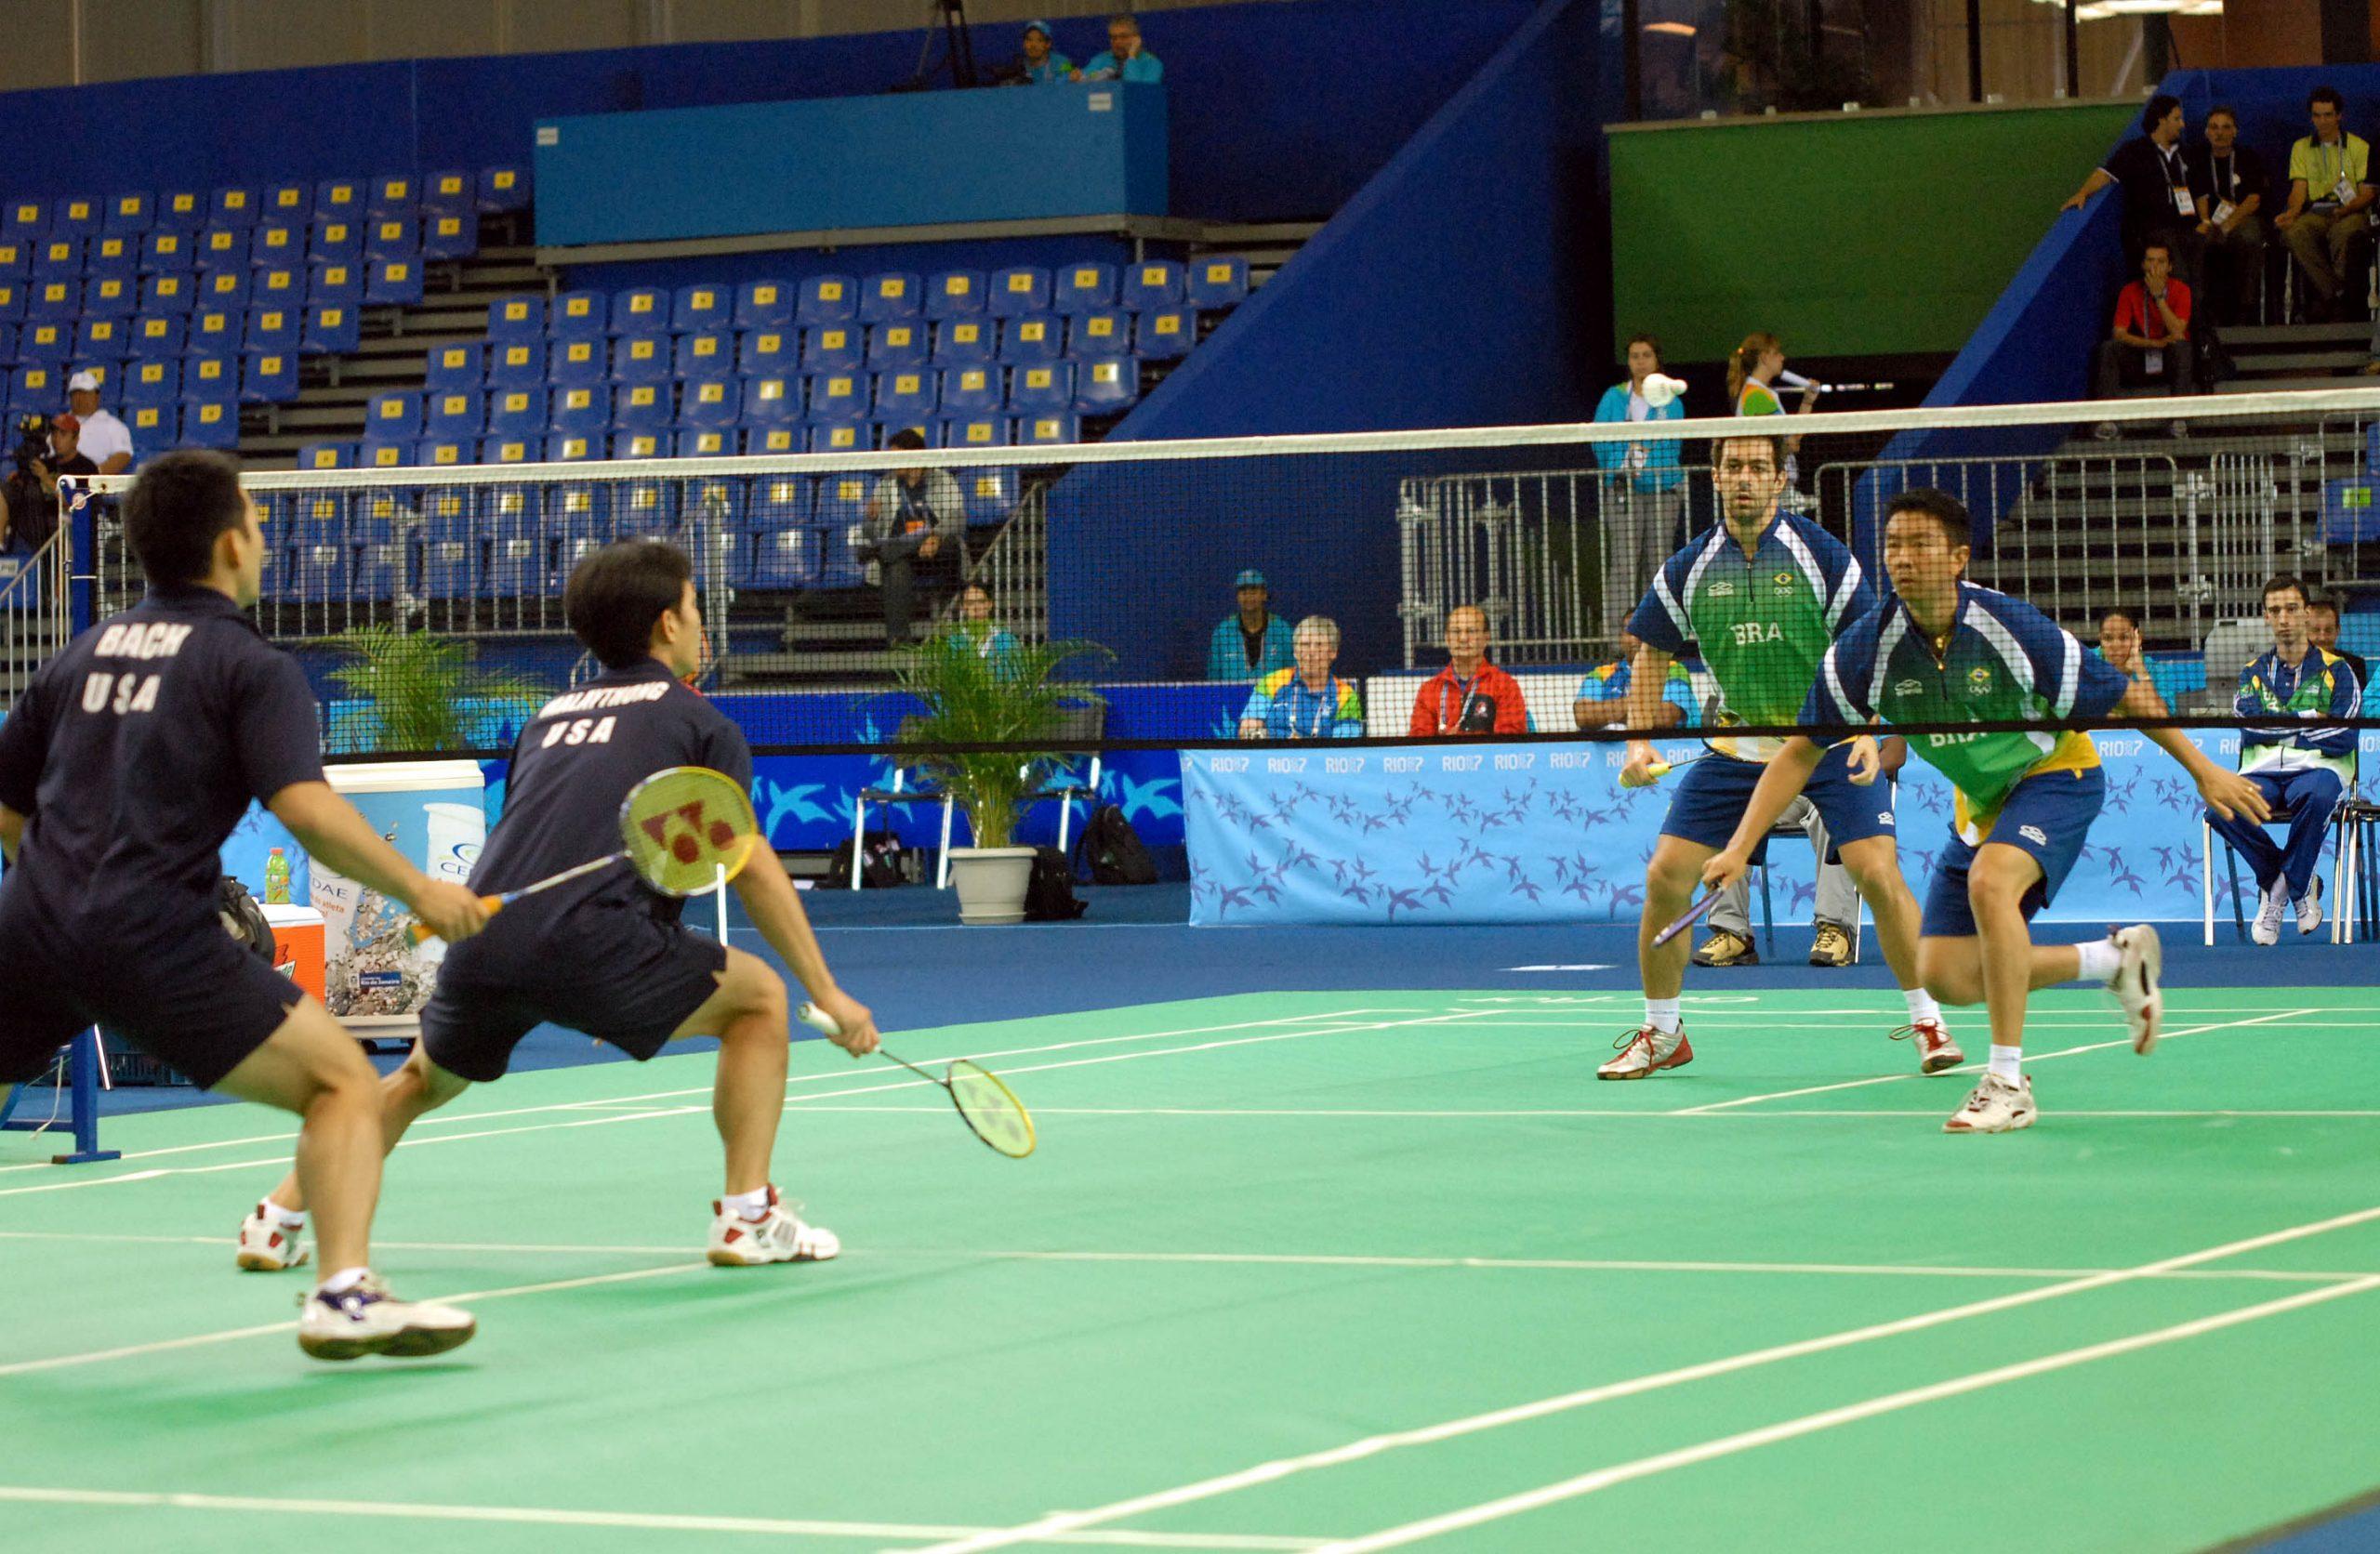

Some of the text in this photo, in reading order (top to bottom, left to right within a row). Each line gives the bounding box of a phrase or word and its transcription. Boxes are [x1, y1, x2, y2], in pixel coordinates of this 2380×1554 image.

[1729, 622, 1784, 645] BRA
[82, 672, 161, 715] USA
[541, 716, 617, 749] USA
